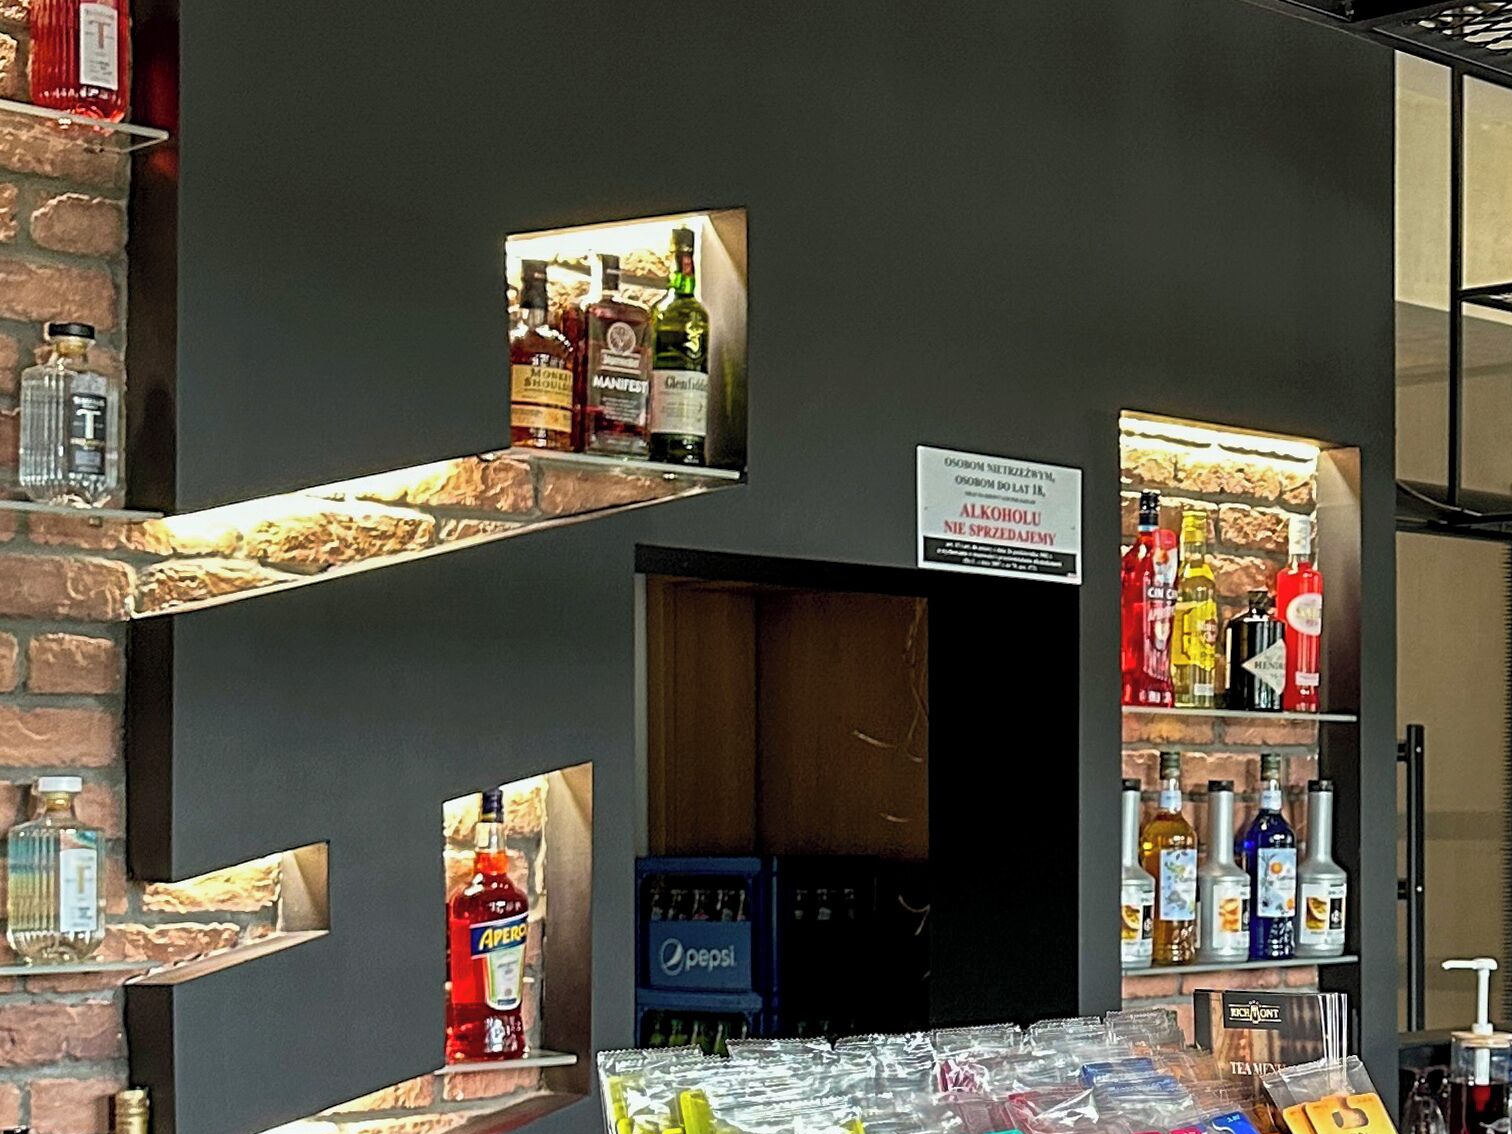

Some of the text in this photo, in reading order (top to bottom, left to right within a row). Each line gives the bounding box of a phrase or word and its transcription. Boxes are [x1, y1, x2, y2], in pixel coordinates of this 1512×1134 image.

[592, 374, 649, 394] MANIFEST
[944, 456, 985, 473] OSOBOM
[955, 475, 995, 491] OSOBOM
[997, 480, 1011, 492] DO
[1012, 482, 1030, 495] LAT
[960, 502, 1042, 527] ALKOHOLU
[943, 519, 1057, 547] NIE SPRZEDAJEMY
[684, 944, 737, 972] pepsi
[1230, 1003, 1280, 1025] RICHMONT
[1230, 1061, 1252, 1076] TEA
